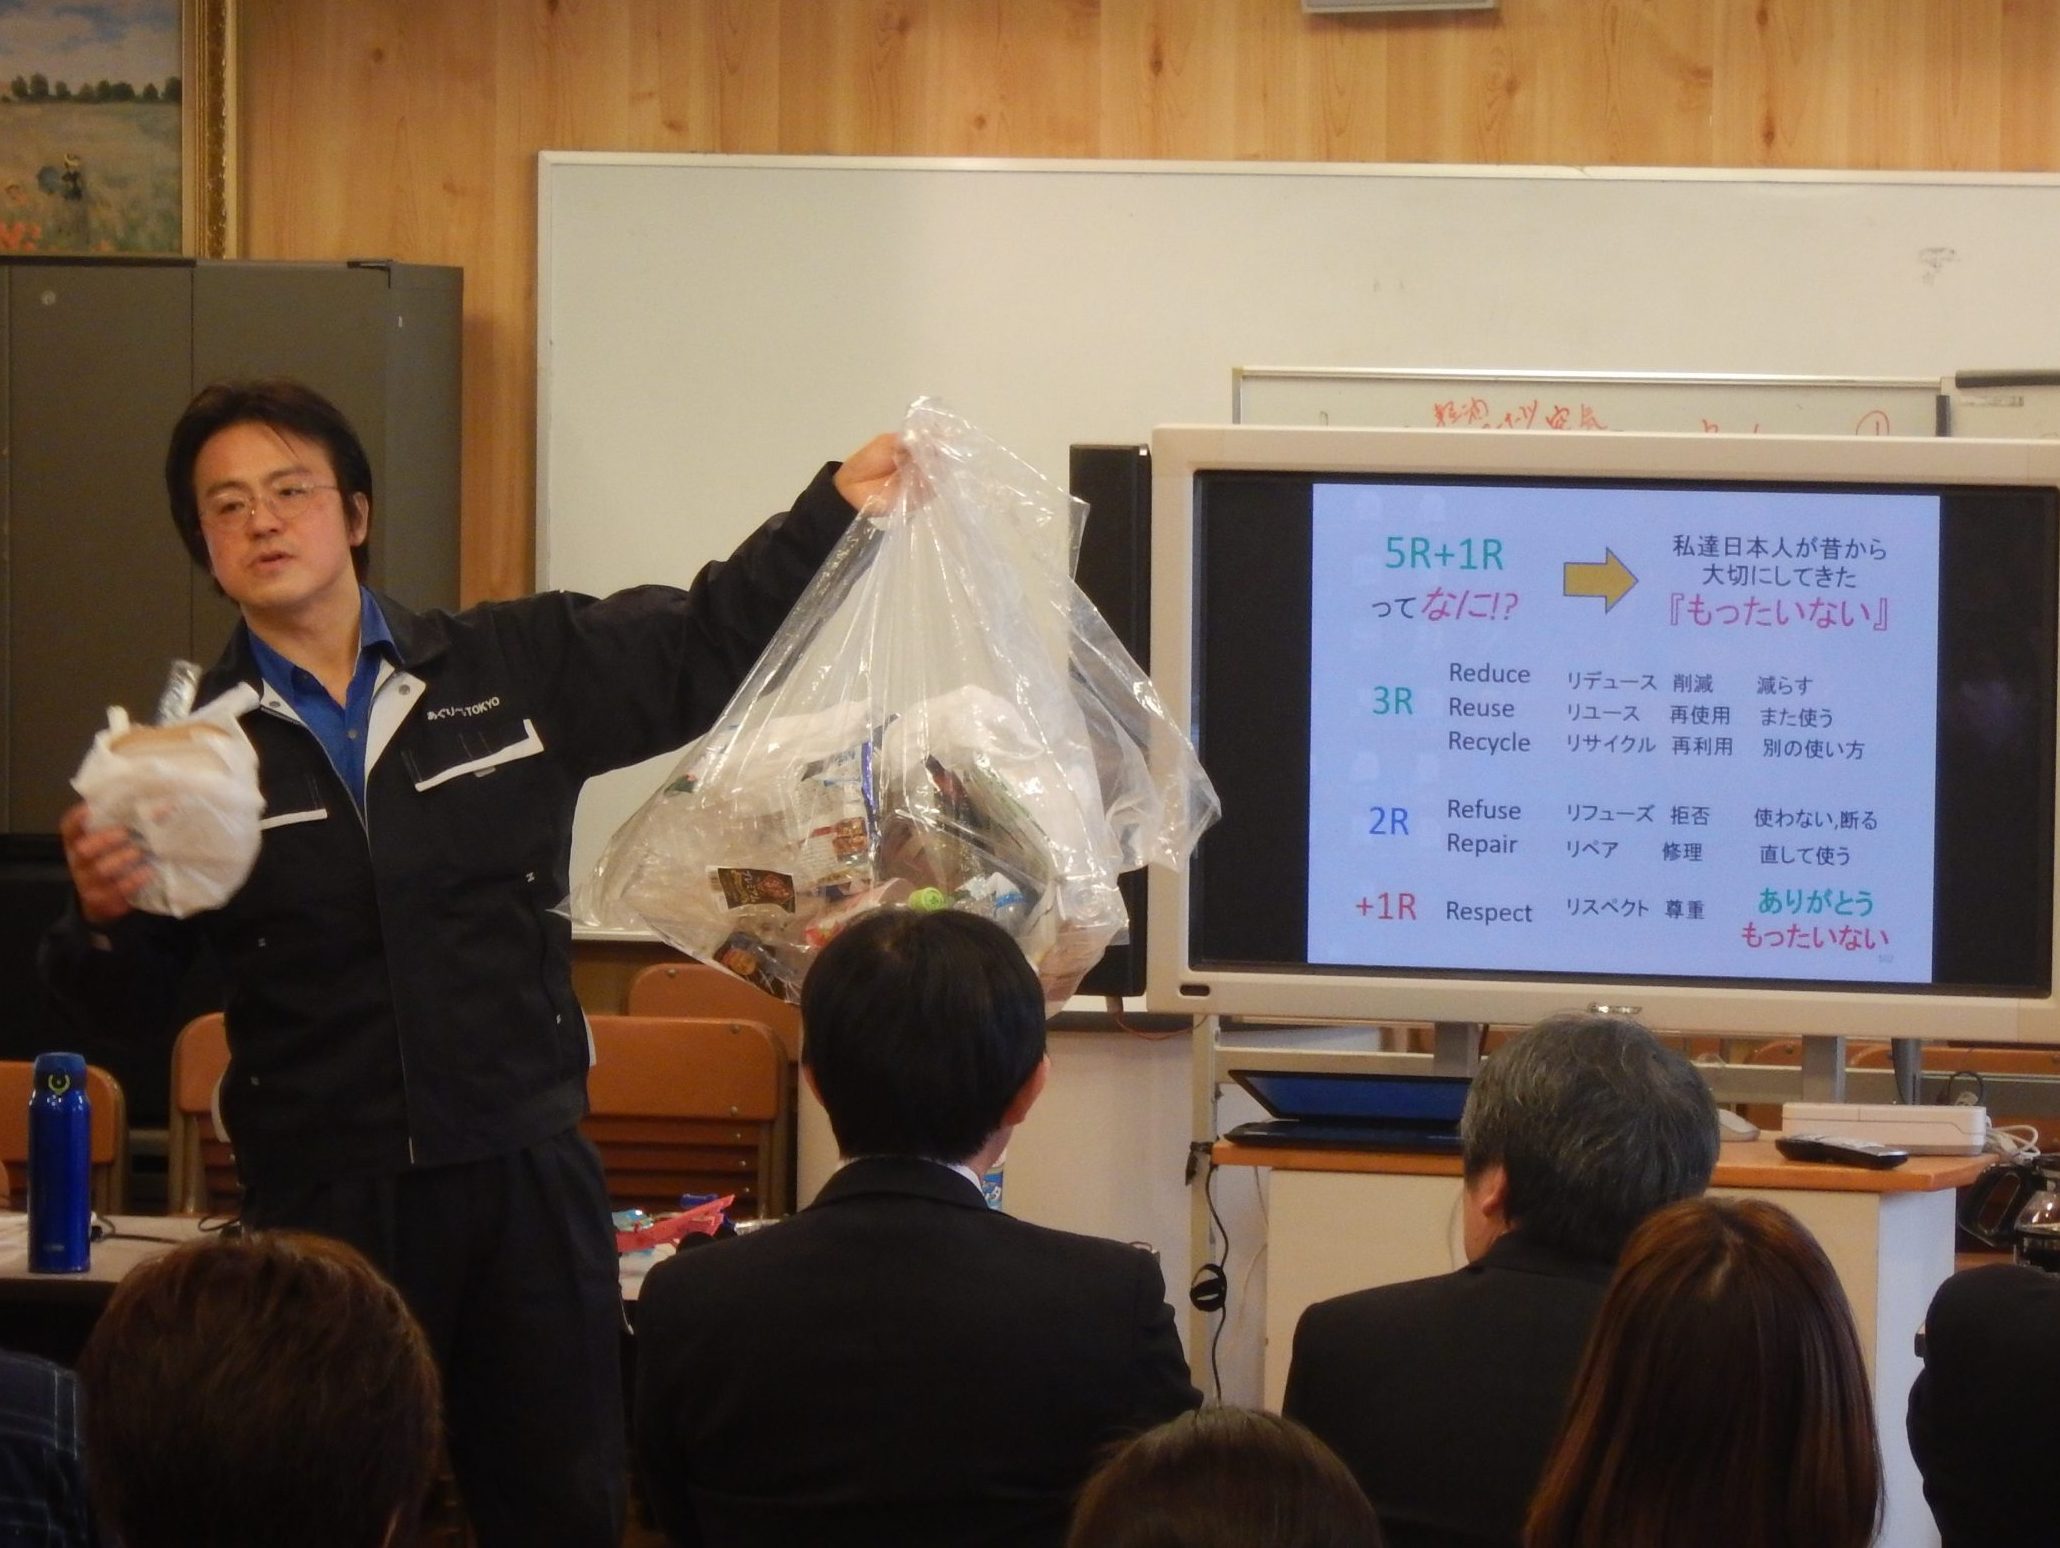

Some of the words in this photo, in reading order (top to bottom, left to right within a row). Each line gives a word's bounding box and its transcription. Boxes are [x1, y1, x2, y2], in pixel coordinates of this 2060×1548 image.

[1386, 537, 1502, 569] 5R+1R
[1673, 535, 1886, 560] 私達日本人が昔から
[1703, 563, 1856, 588] 大切にしてきた
[1450, 663, 1530, 683] Reduce
[1569, 671, 1657, 690] リデュース
[1674, 674, 1712, 692] 削減
[1757, 676, 1812, 695] 減らす
[1373, 686, 1412, 714] 3R
[1450, 697, 1514, 717] Reuse
[1569, 704, 1639, 721] リユース
[1671, 706, 1729, 724] 再使用
[1761, 708, 1832, 728] また使う
[1449, 731, 1530, 755] Recycle
[1568, 735, 1656, 753] リサイクル
[1673, 736, 1732, 755] 再利用
[1764, 739, 1864, 759] 別の使い方
[1370, 807, 1408, 835] 2R
[1448, 799, 1521, 820] Refuse
[1568, 805, 1654, 822] リフューズ
[1671, 806, 1709, 825] 拒否
[1448, 833, 1518, 857] Repair
[1568, 841, 1618, 858] リペア
[1663, 843, 1701, 861] 修理
[1761, 845, 1849, 865] 直して使う
[1356, 893, 1416, 920] +1R
[1447, 901, 1532, 925] Respect
[1568, 899, 1648, 917] リスペクト
[1666, 900, 1702, 919] 尊重
[1759, 888, 1872, 916] ありがとう
[1742, 922, 1888, 950] もったいない
